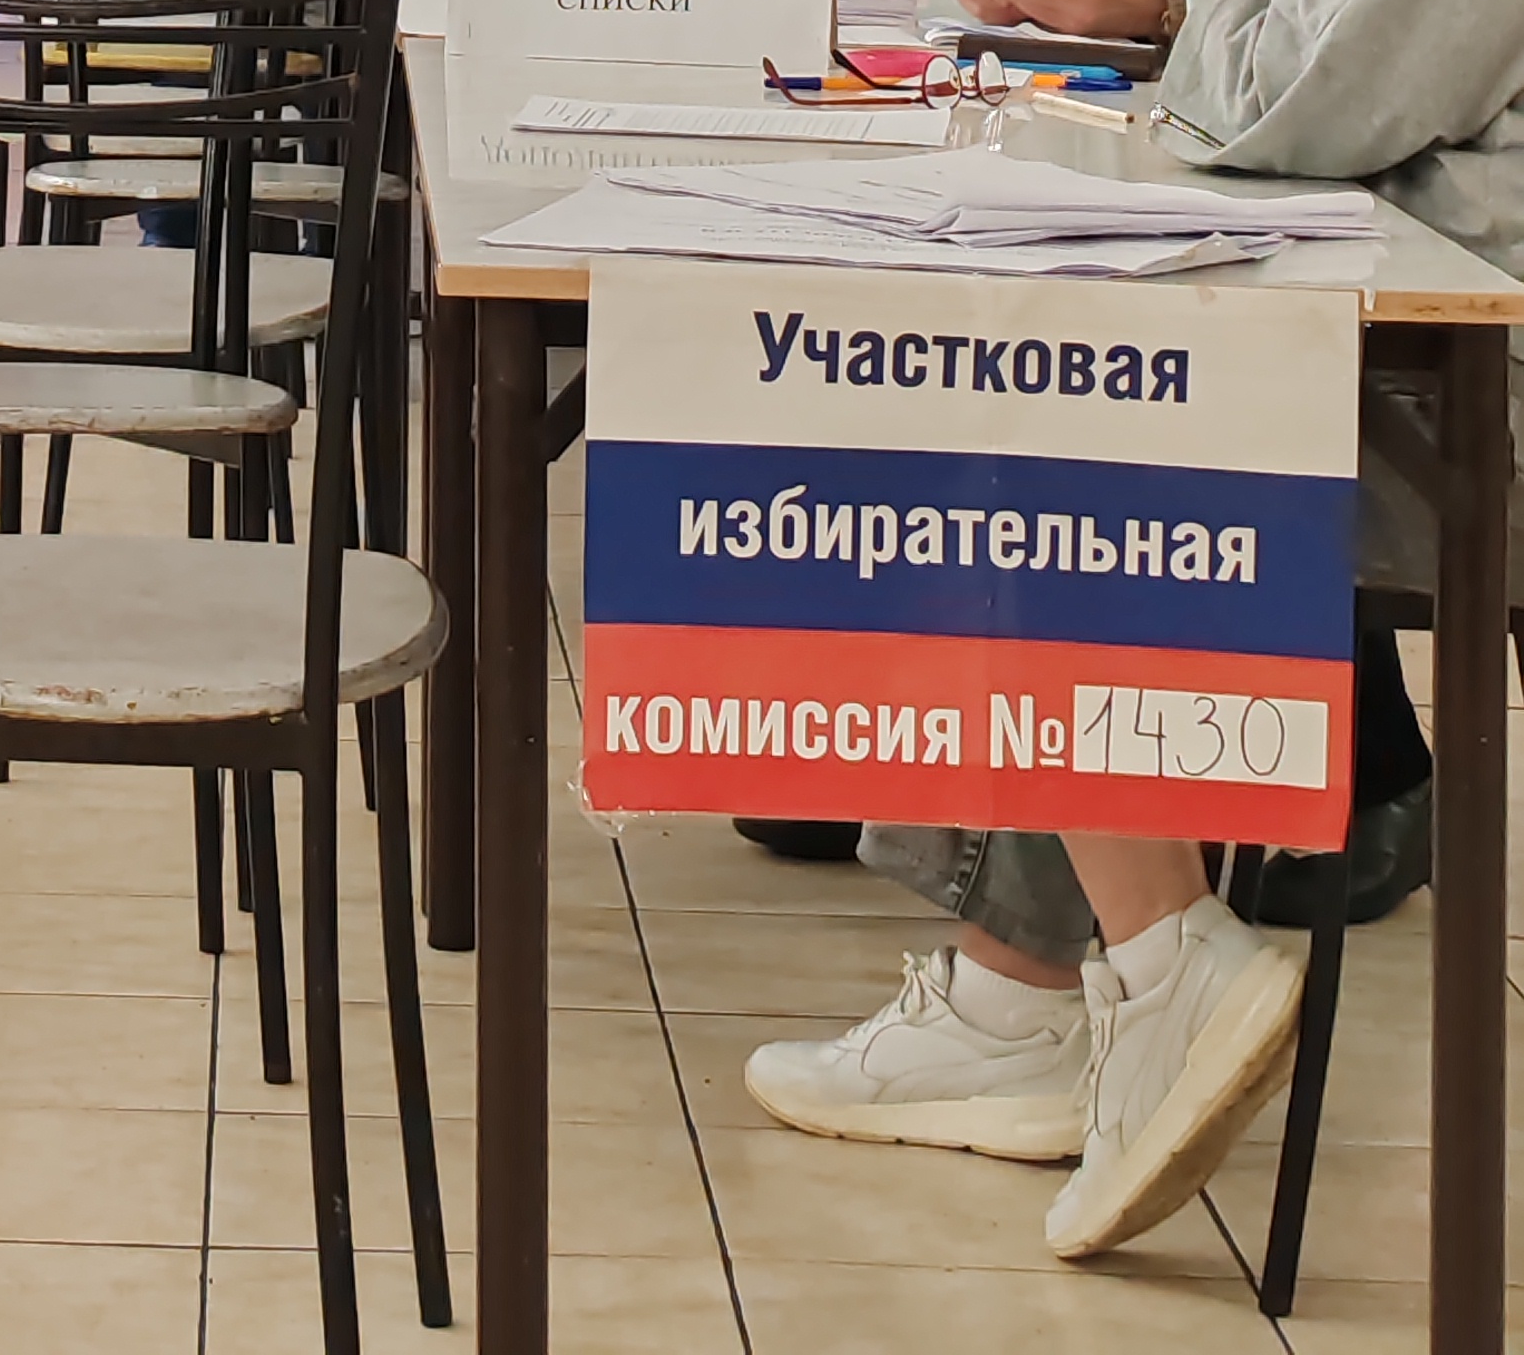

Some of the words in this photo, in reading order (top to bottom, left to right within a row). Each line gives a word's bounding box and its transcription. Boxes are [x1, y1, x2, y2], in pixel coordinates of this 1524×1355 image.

[754, 309, 1190, 403] Участковая
[679, 485, 1258, 584] избирательная
[1083, 687, 1287, 778] 1430
